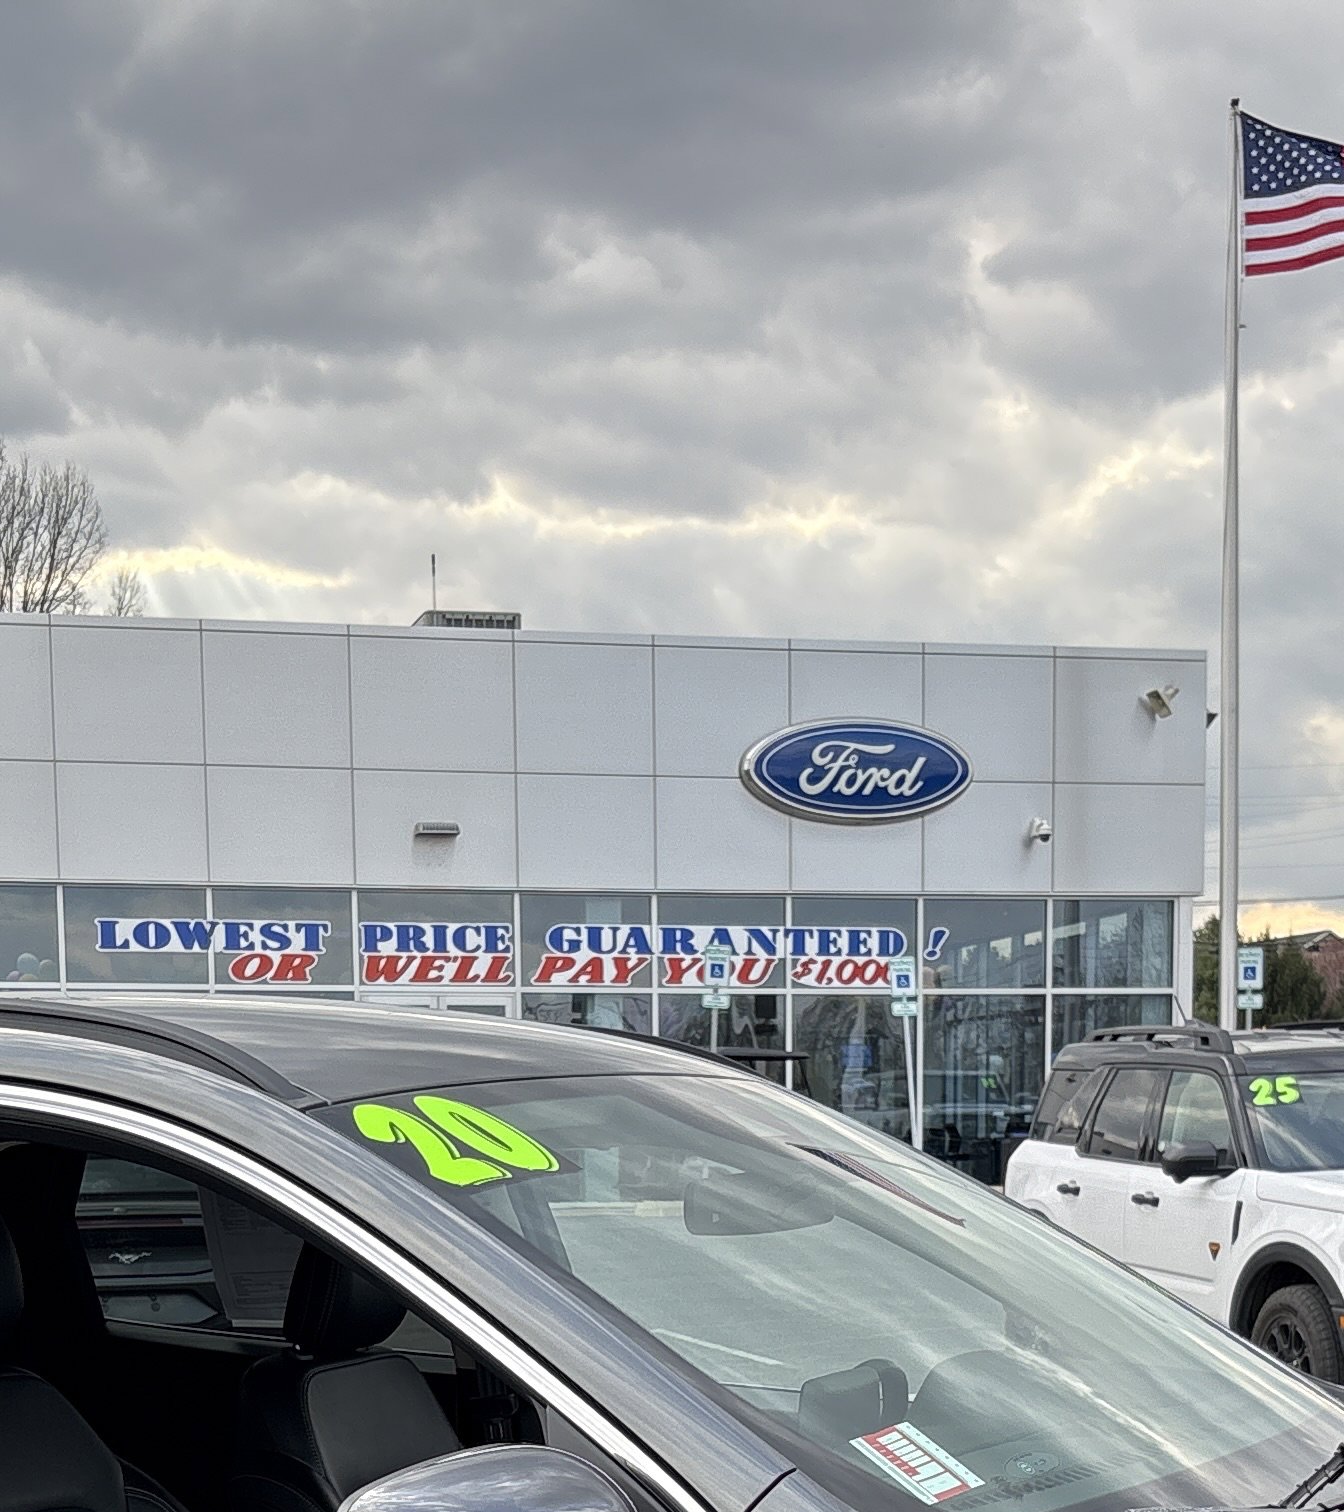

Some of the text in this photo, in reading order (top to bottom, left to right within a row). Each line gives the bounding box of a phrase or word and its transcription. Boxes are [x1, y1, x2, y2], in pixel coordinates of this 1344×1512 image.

[798, 740, 928, 798] Ford
[98, 921, 330, 952] LOWEST
[360, 924, 511, 953] PRICE
[548, 926, 906, 957] GUARANTEED
[231, 954, 315, 981] OR
[365, 955, 513, 982] WE'LL
[534, 957, 649, 984] PAY
[1249, 1076, 1300, 1106] 25
[353, 1095, 560, 1187] 20
